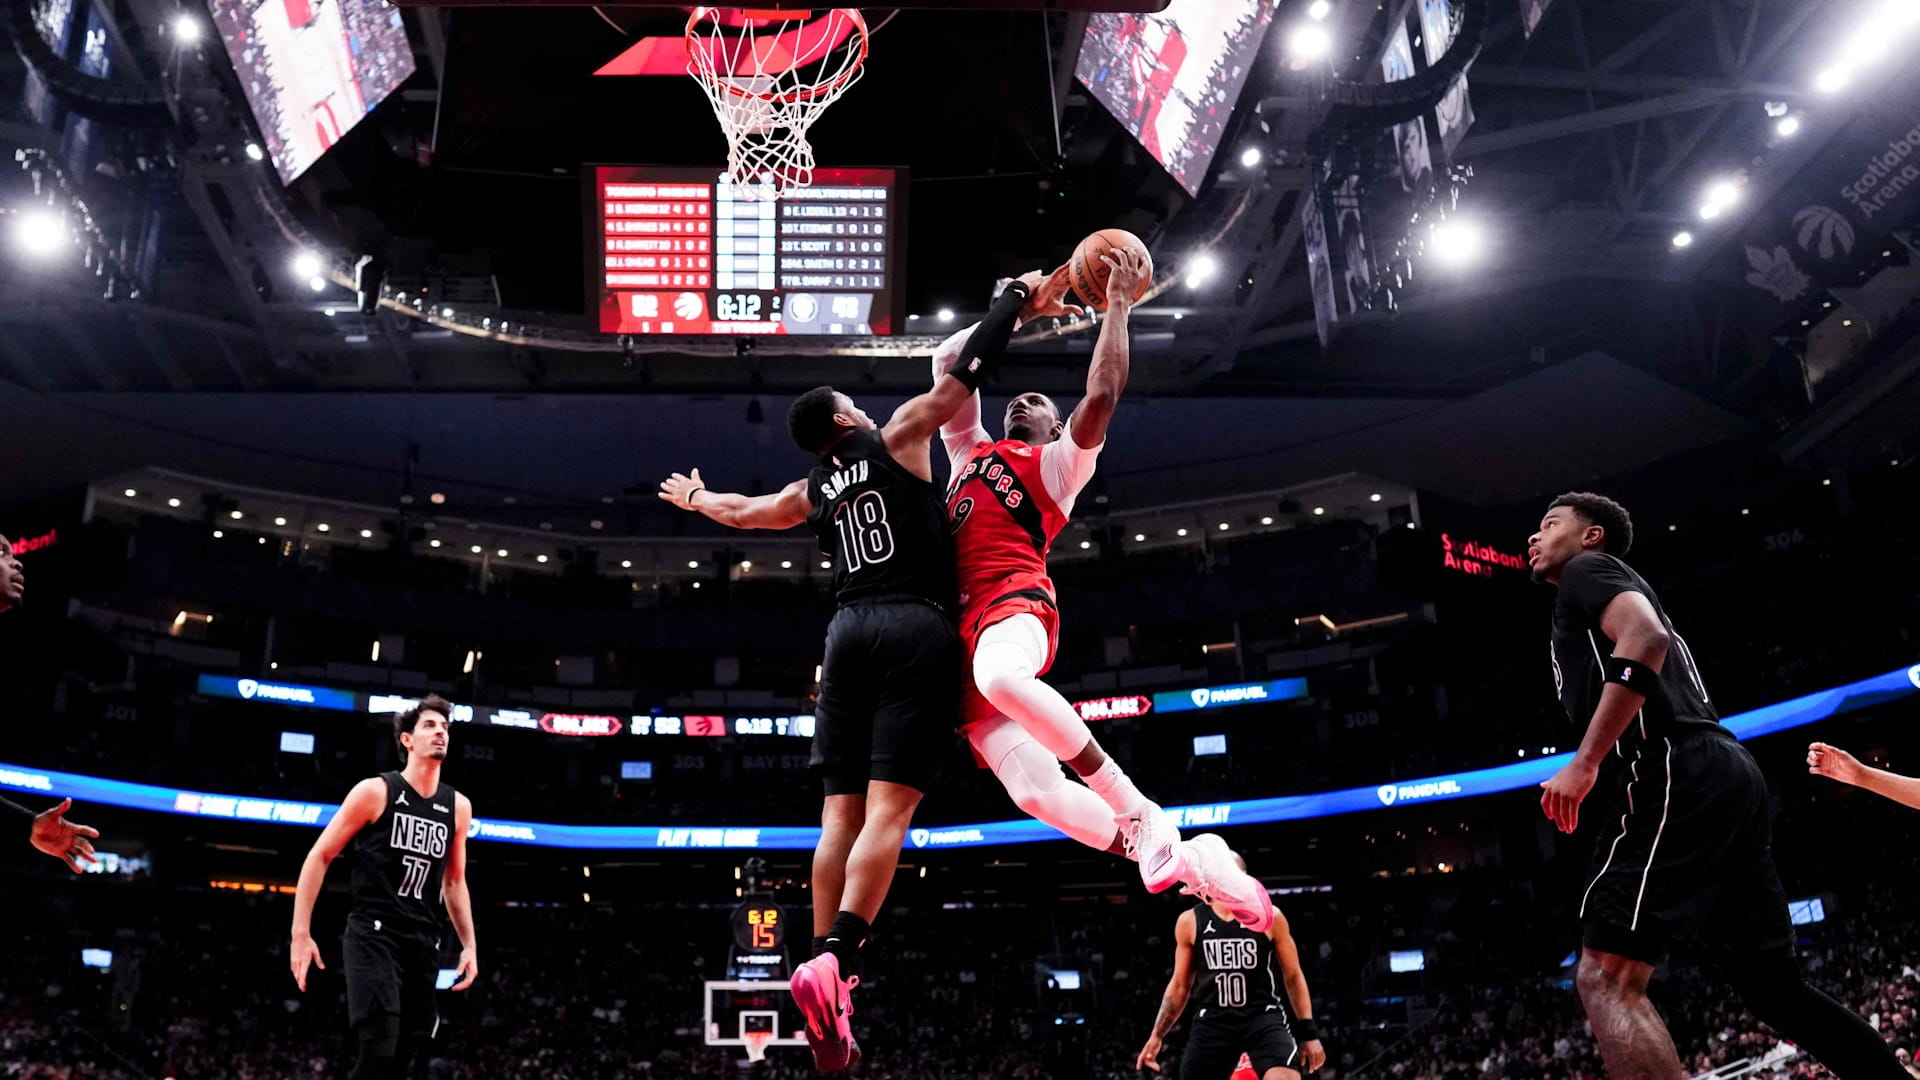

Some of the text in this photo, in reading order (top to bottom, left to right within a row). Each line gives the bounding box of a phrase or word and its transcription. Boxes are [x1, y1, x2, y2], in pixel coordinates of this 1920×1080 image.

[1841, 123, 1920, 205] Scotiaba
[849, 258, 856, 269] 2
[717, 294, 761, 320] 6:12
[820, 459, 869, 500] SMITH
[833, 490, 894, 573] 18
[952, 496, 975, 535] 9
[1211, 685, 1267, 703] FANDUEL
[1398, 779, 1461, 801] FANDUEL
[390, 812, 448, 858] NETS
[398, 854, 431, 900] 77
[752, 923, 776, 948] 15
[1203, 938, 1258, 970] NETS
[1215, 972, 1247, 1008] 10
